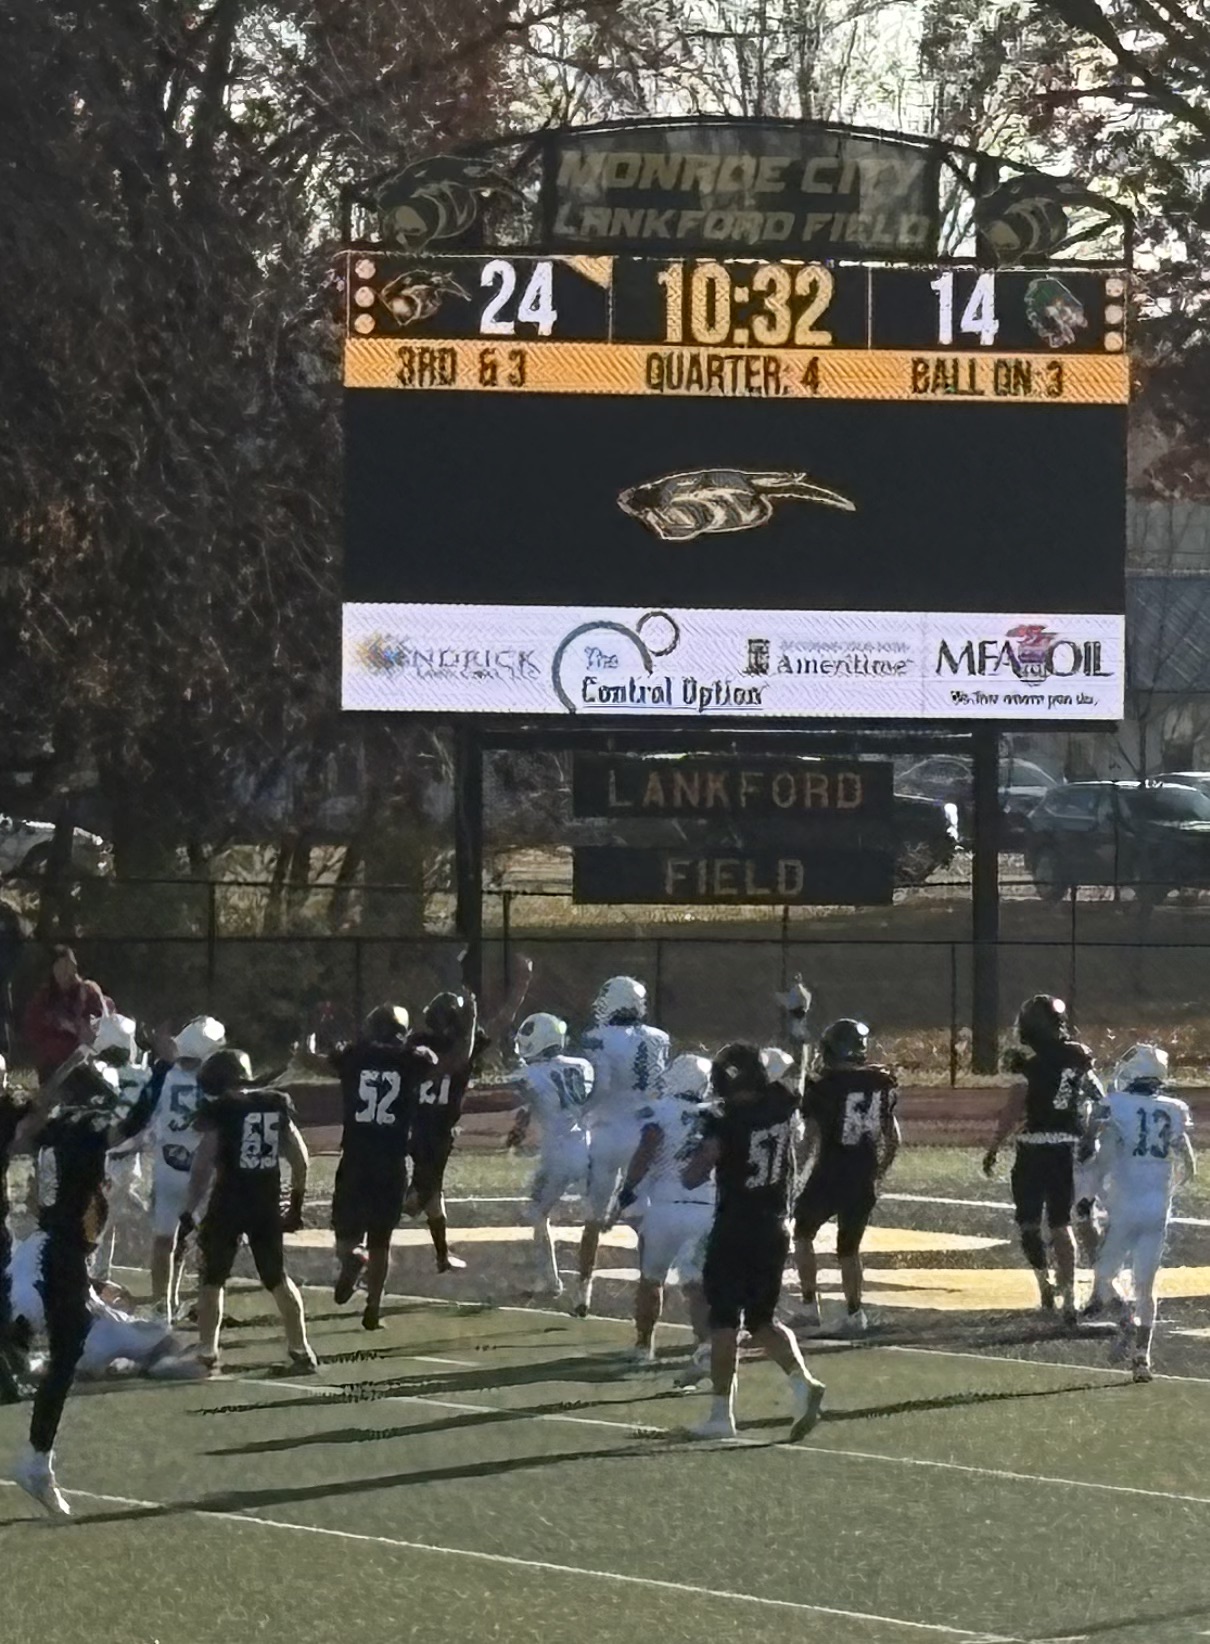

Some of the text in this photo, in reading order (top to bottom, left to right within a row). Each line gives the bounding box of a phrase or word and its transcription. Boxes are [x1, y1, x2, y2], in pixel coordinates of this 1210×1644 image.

[556, 151, 926, 195] MONROE CITY
[553, 204, 930, 244] LANKFORD FIELD
[480, 259, 558, 336] 24
[658, 262, 834, 346] 10:32
[930, 270, 999, 346] 14
[508, 349, 526, 387] 3
[800, 357, 820, 394] 4
[911, 357, 984, 395] BALL
[1047, 360, 1064, 397] 3
[936, 640, 1114, 679] MFA OIL
[608, 769, 862, 809] LANKFORD
[666, 858, 804, 896] FIELD
[355, 1069, 401, 1125] 52
